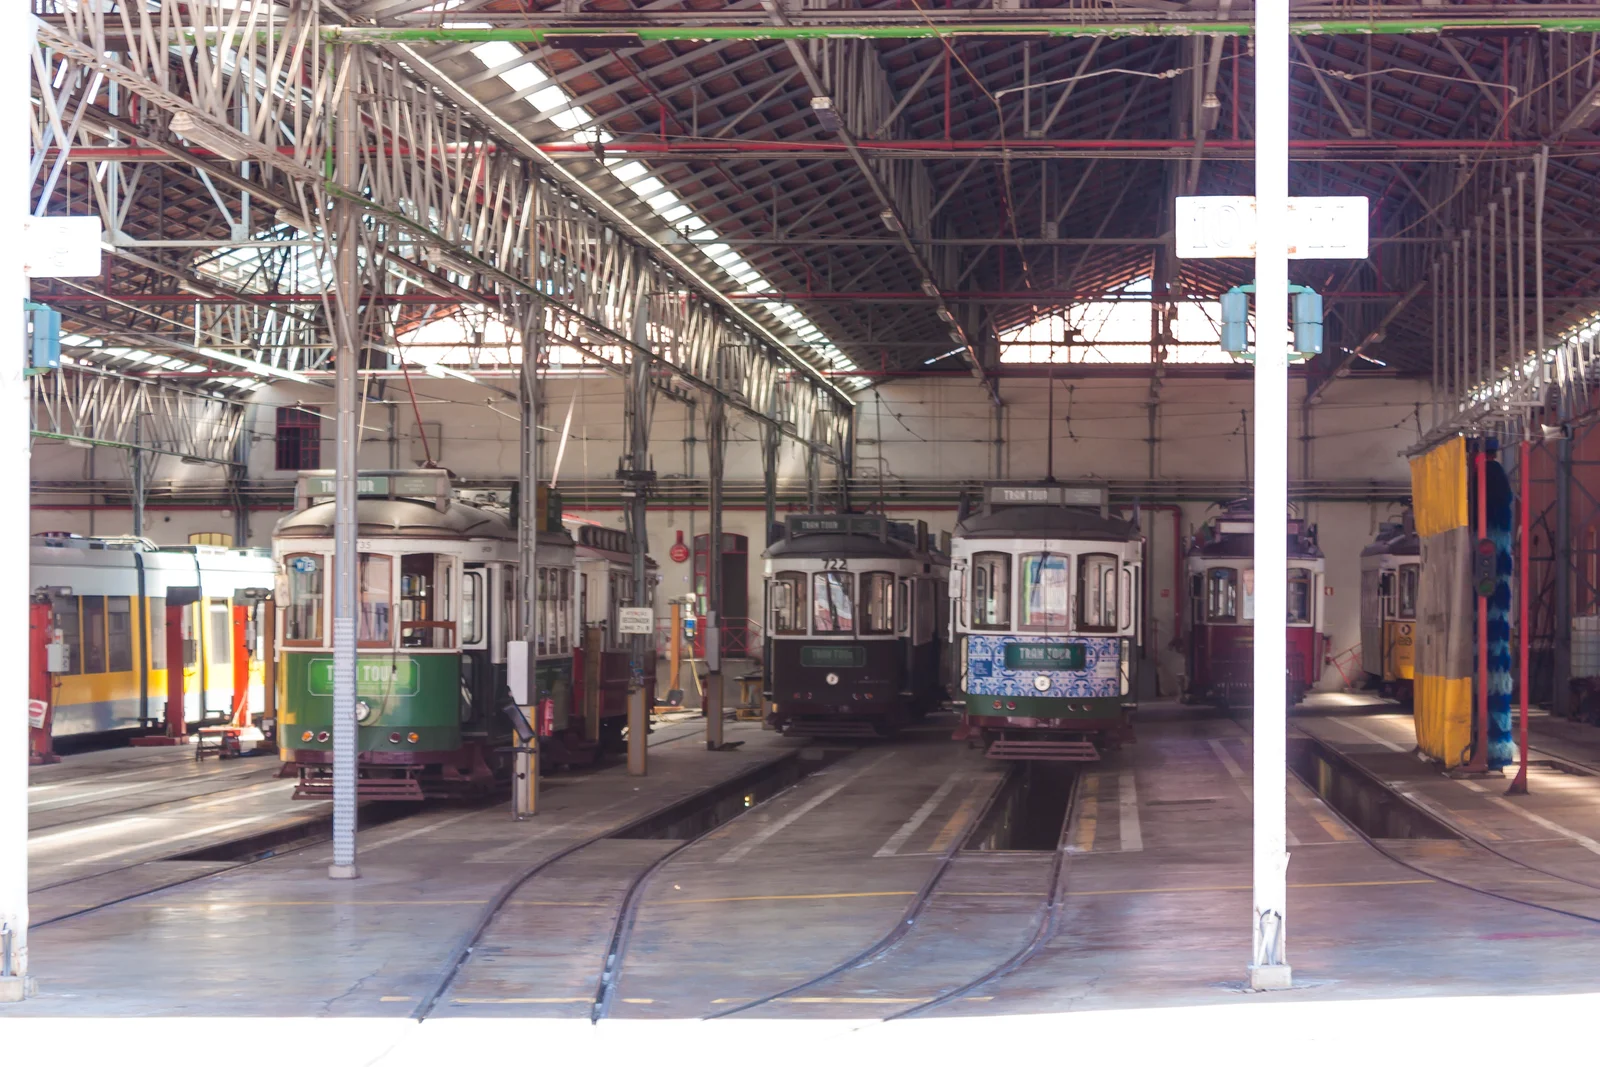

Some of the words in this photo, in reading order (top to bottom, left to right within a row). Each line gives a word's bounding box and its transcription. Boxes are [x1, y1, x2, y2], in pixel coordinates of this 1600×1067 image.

[1192, 205, 1241, 248] 10
[821, 558, 848, 570] 722
[1019, 648, 1044, 659] TRAM
[1046, 648, 1072, 659] TOUR
